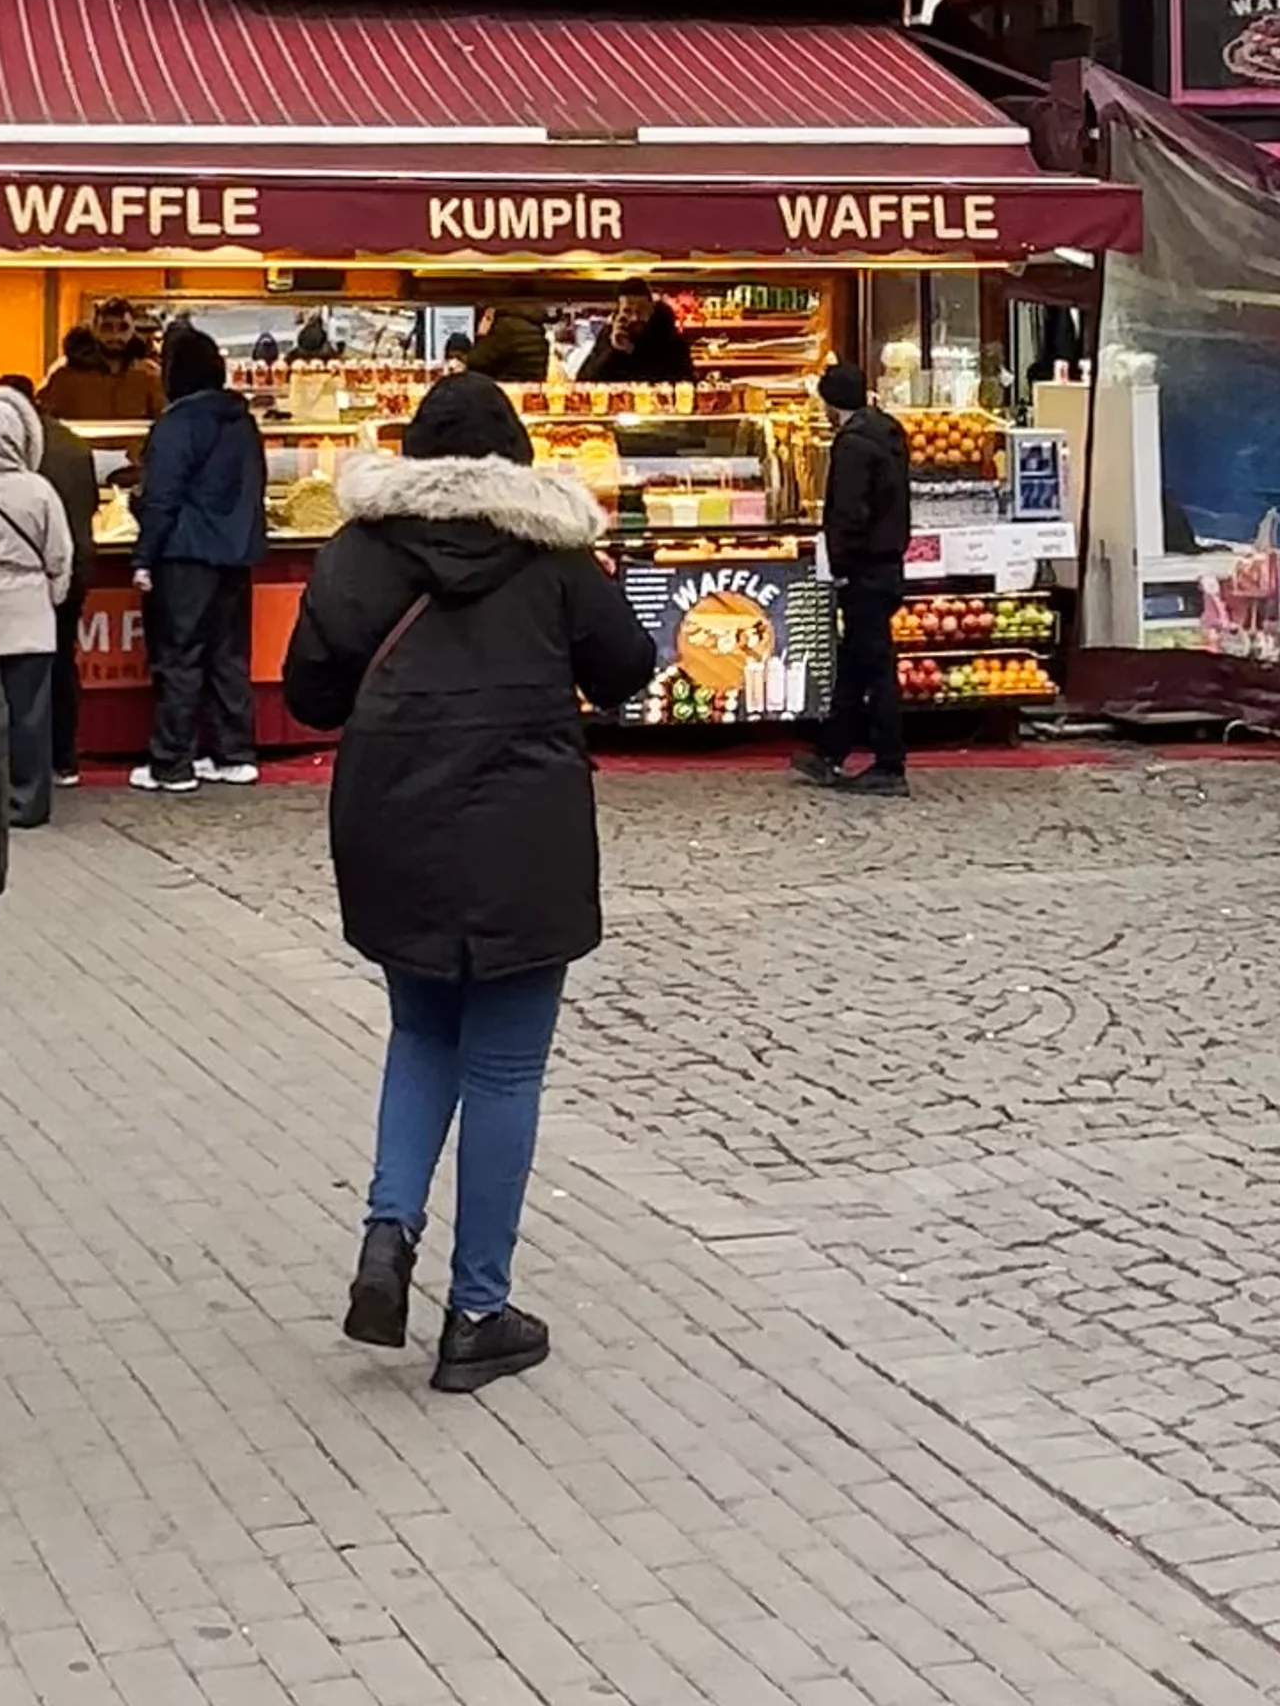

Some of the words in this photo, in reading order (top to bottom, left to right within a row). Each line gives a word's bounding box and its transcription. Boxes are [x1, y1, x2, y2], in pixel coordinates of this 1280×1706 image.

[4, 185, 262, 238] WAFFLE
[427, 191, 624, 241] KUMPİR
[777, 193, 1000, 242] WAFFLE
[671, 568, 781, 612] WAFFLE
